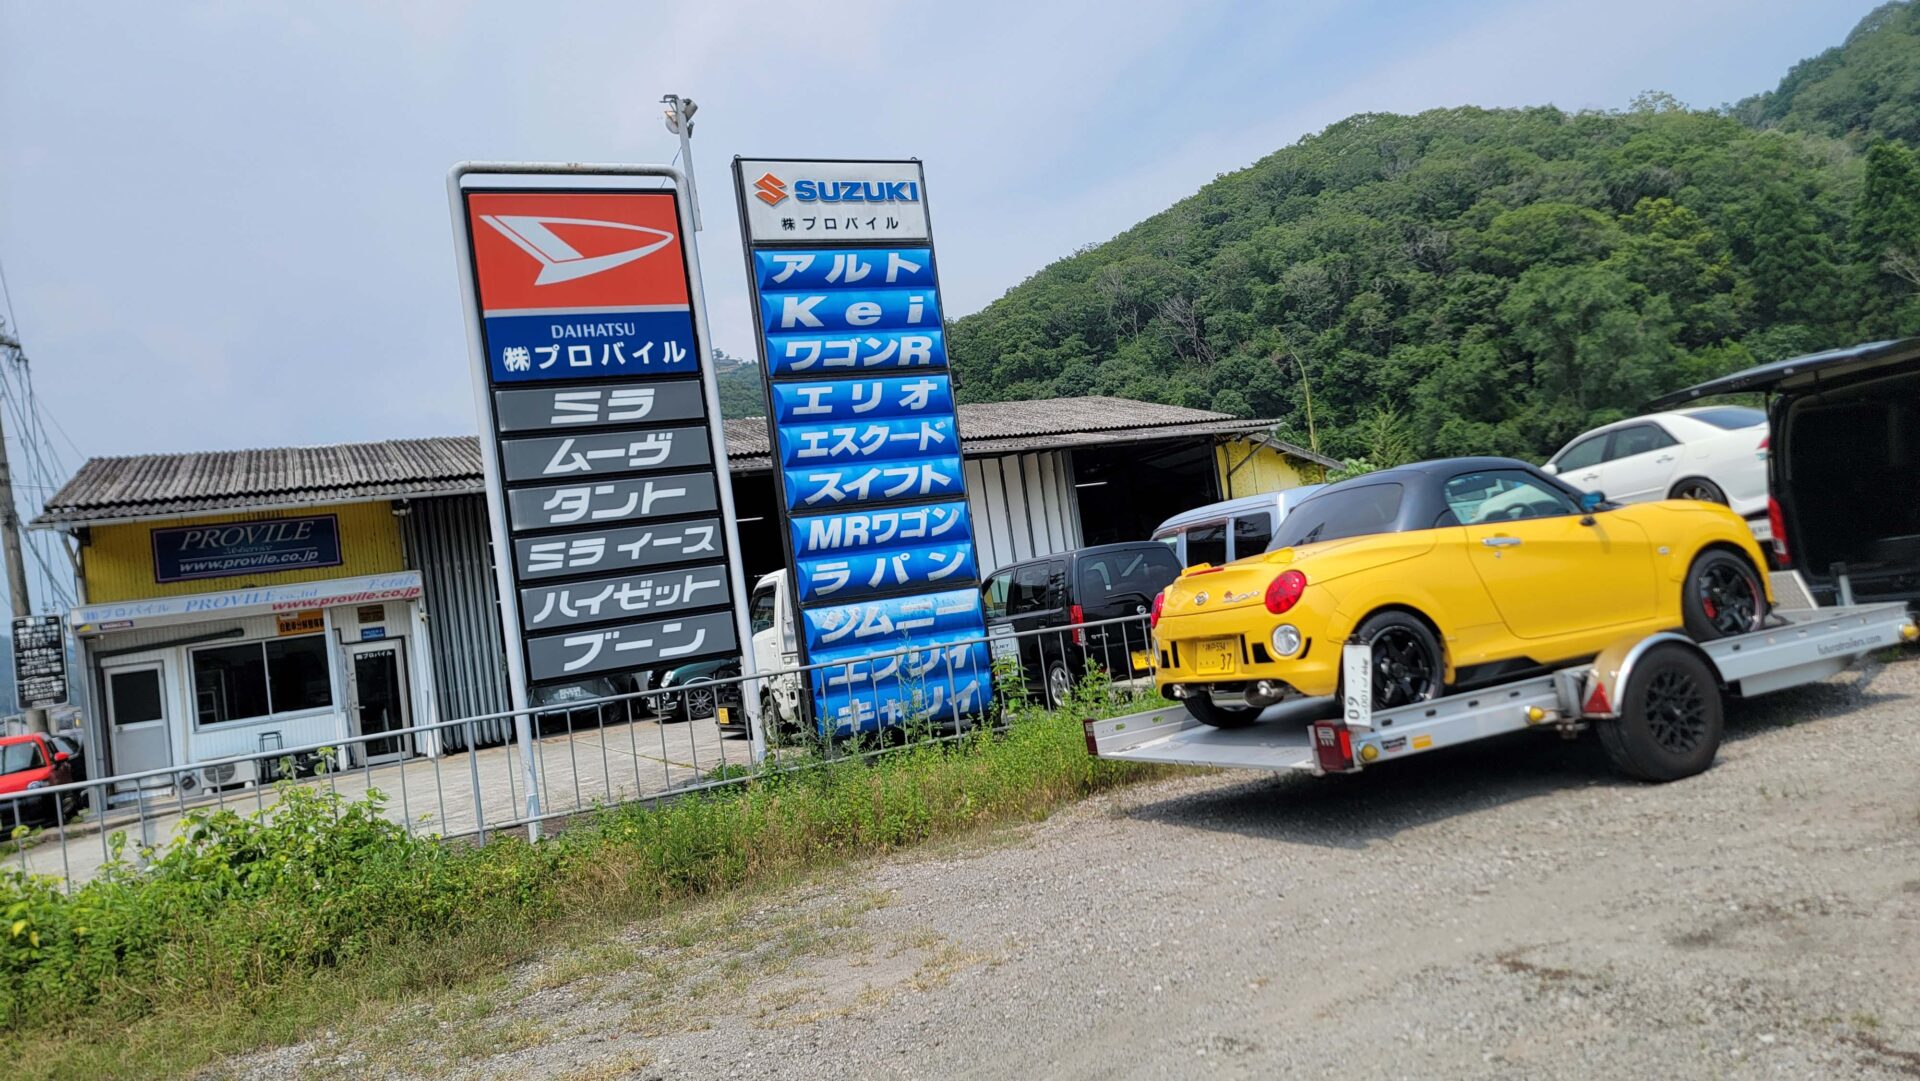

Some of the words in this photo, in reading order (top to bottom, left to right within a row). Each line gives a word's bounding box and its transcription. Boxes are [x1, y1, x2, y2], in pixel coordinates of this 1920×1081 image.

[794, 180, 919, 203] SUZUKI
[772, 253, 921, 284] アルト
[551, 322, 636, 339] DAIHATSU
[781, 296, 924, 329] Kei
[785, 336, 933, 371] ワゴンR
[550, 388, 655, 424] ミラ
[792, 379, 937, 415] エリオ
[542, 432, 673, 475] ムーヴ
[797, 421, 946, 458] エスクード
[543, 481, 686, 523] タント
[804, 464, 952, 506] スイフト
[180, 520, 315, 550] PROVILE
[808, 507, 960, 551] MRワゴン
[179, 549, 319, 573] www.provile.co.jp
[812, 551, 966, 596] ラパン
[185, 590, 275, 612] PROVILE
[272, 586, 420, 611] www.provile.co.jp
[532, 574, 721, 624] ハイゼット
[563, 622, 706, 672] ブーン
